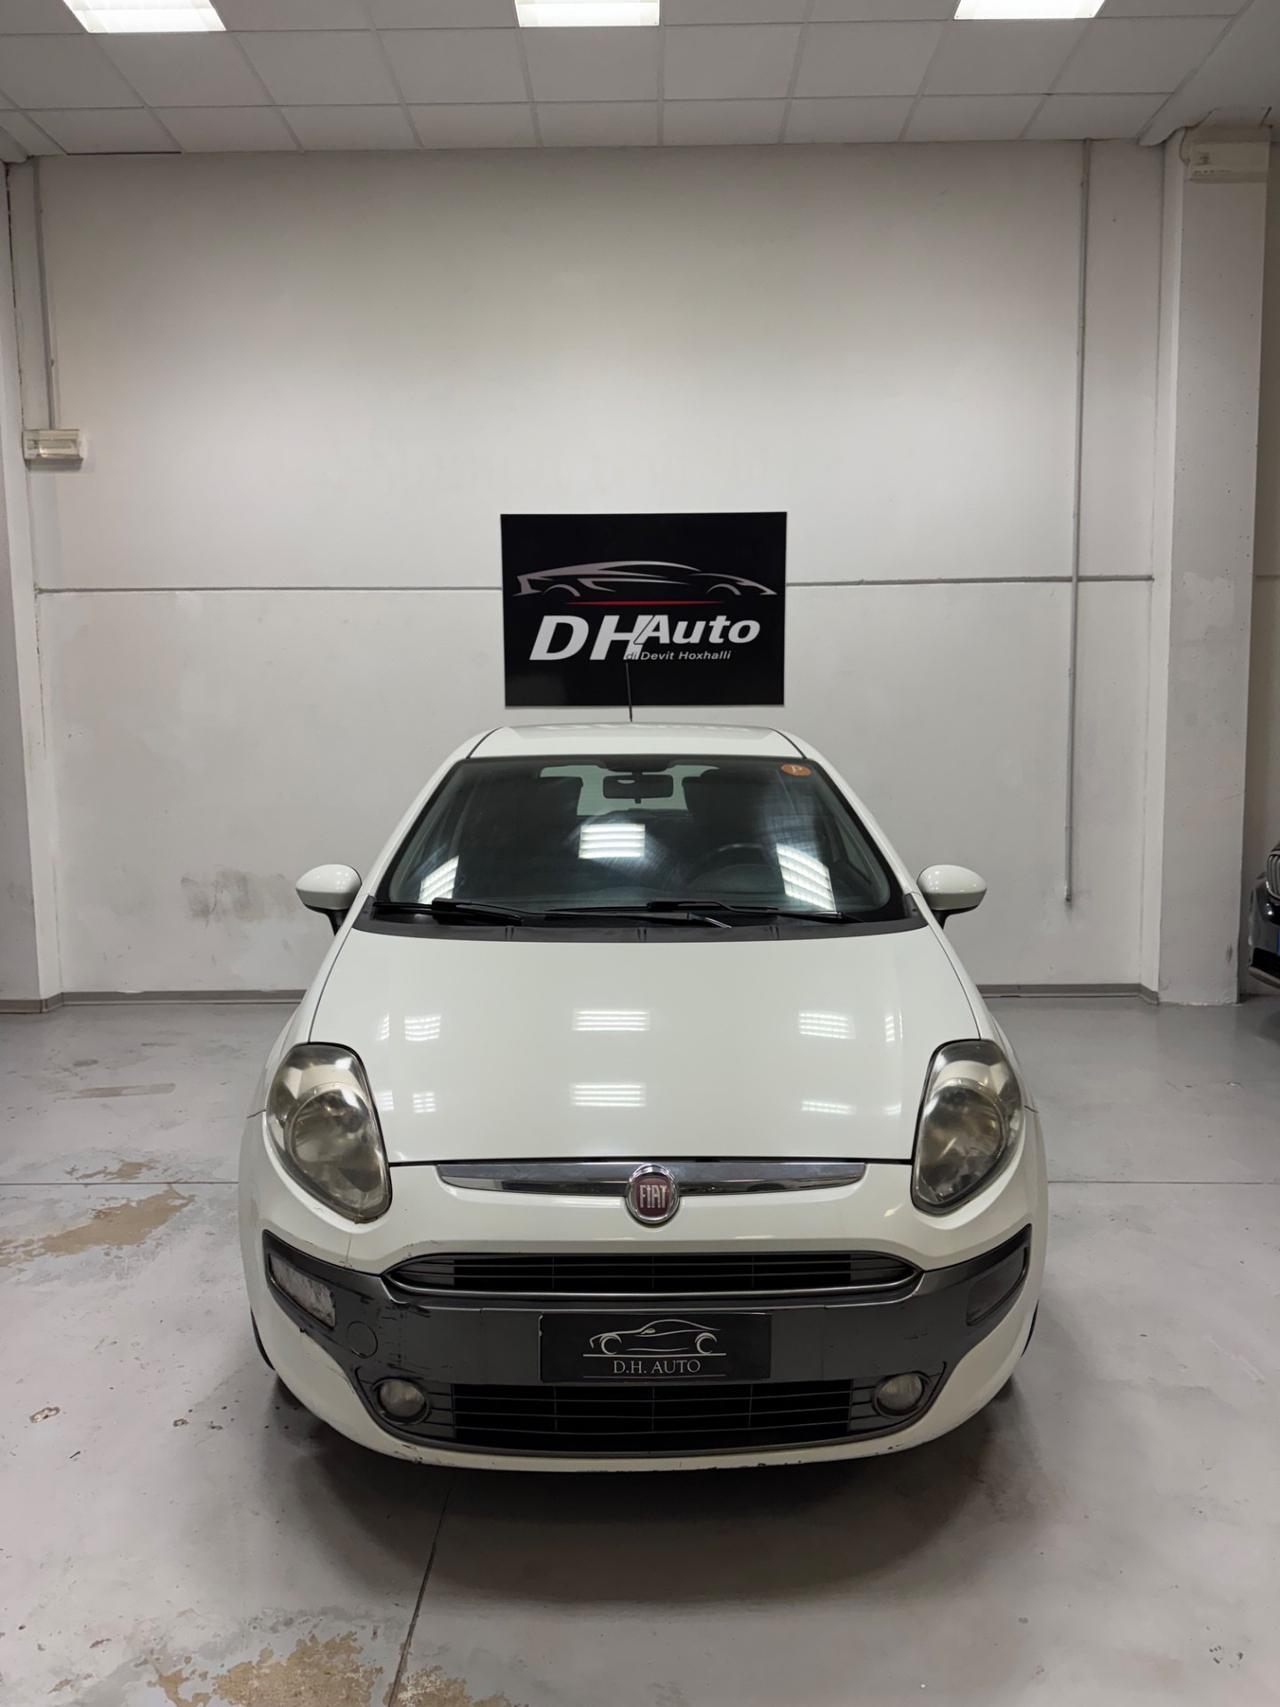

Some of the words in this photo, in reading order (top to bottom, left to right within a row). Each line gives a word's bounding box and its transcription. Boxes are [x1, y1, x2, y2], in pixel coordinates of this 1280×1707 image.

[641, 650, 675, 661] Devit
[678, 650, 732, 660] Hoxhalli
[640, 1184, 668, 1208] FIAT
[613, 1360, 647, 1374] D.H.
[651, 1359, 701, 1374] AUTO
